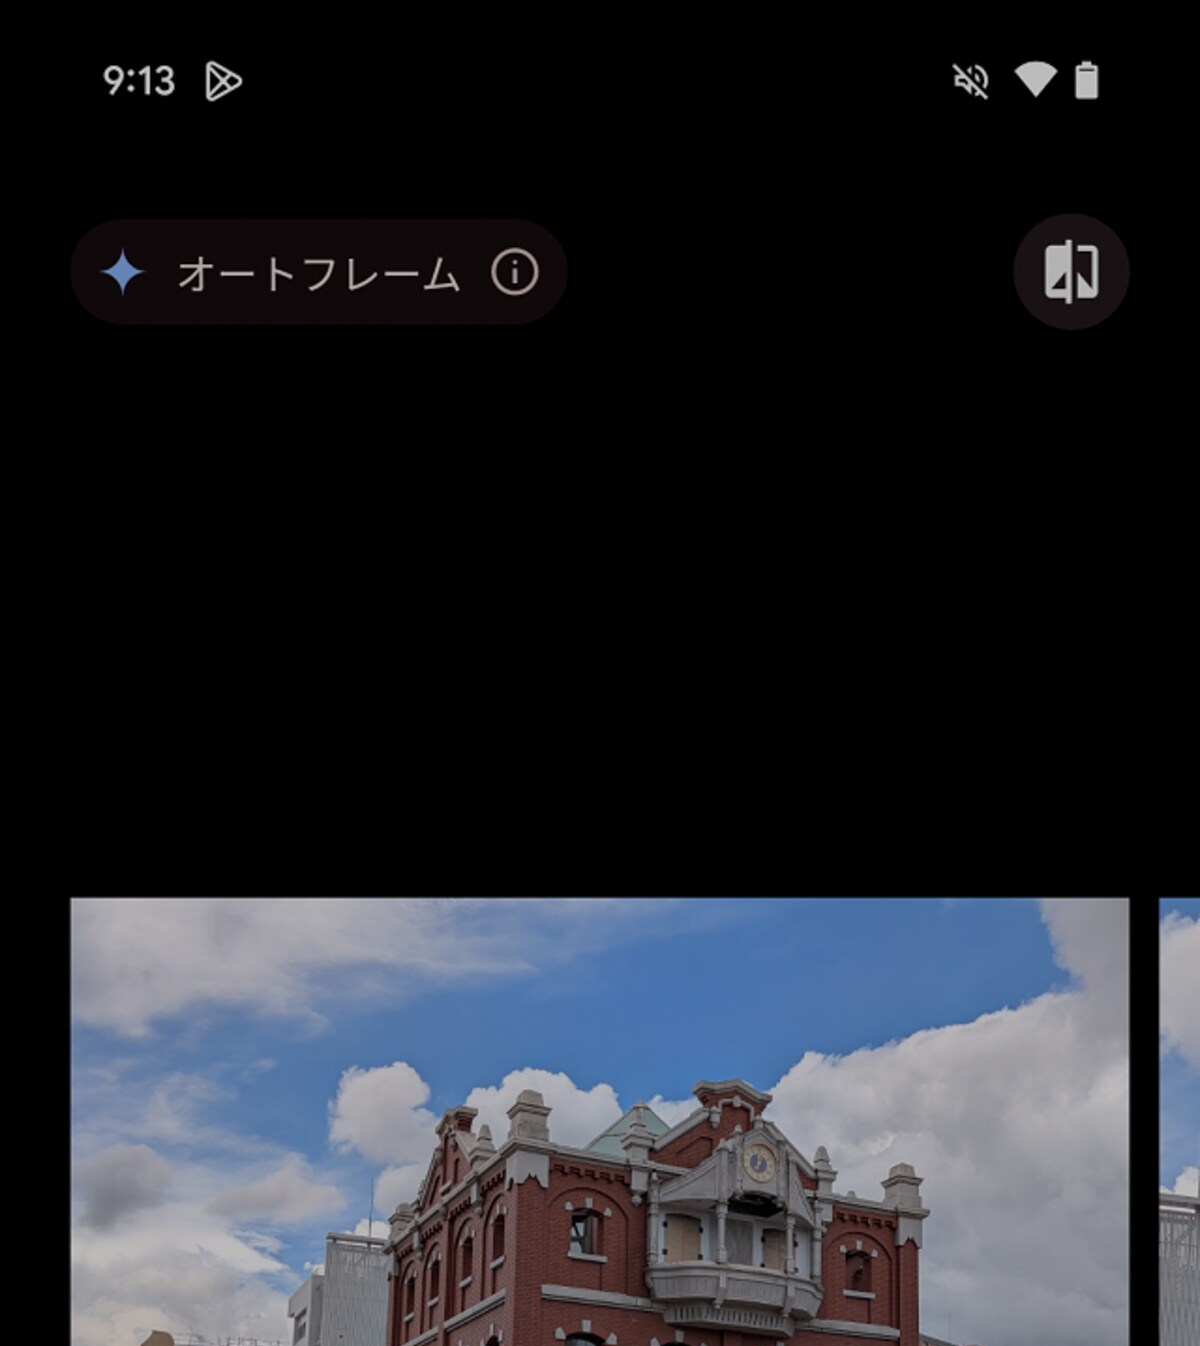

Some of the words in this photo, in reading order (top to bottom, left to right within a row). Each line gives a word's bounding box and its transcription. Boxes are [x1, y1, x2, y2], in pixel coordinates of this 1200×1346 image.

[103, 64, 176, 97] 9:13
[178, 256, 460, 292] オートフレーム
